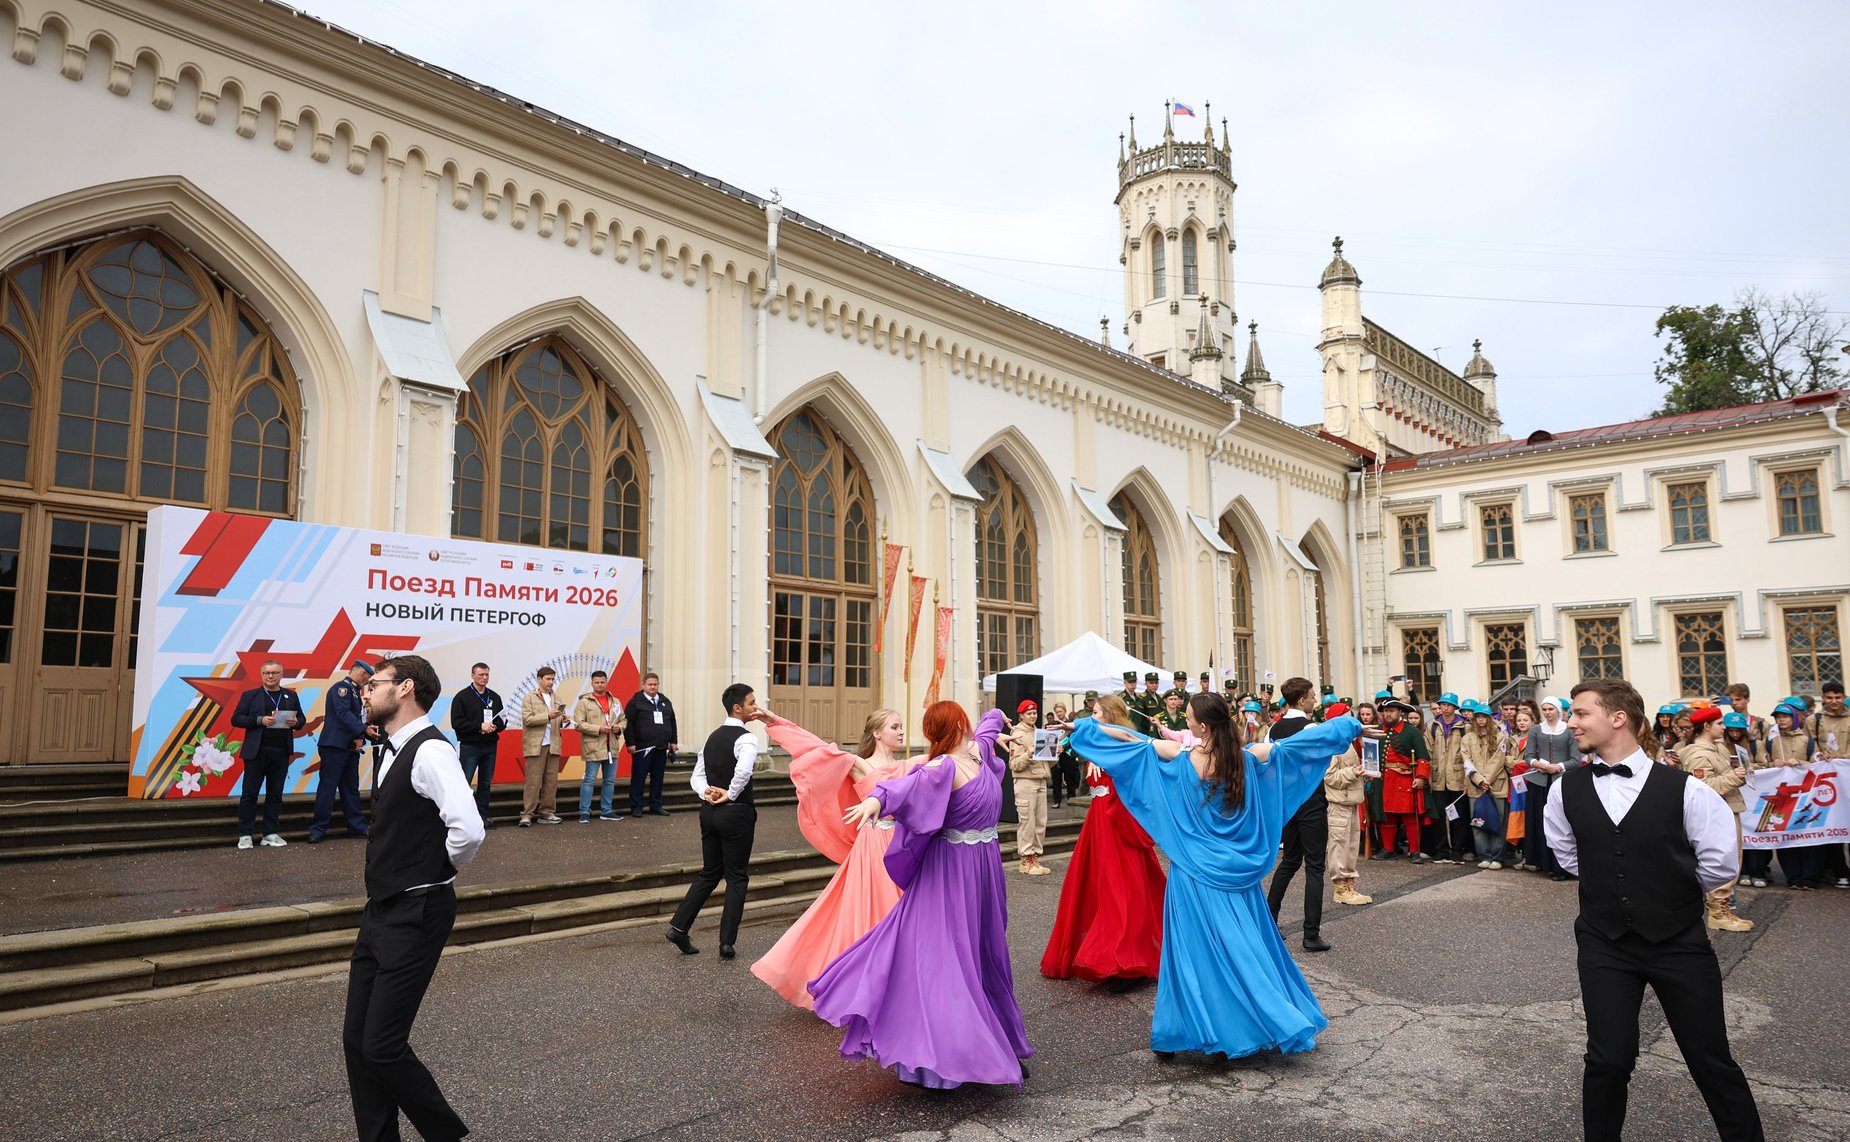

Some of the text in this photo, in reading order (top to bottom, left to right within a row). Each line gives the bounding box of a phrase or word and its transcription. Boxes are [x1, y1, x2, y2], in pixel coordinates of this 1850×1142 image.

[367, 568, 618, 607] Поезд Памяти 2026
[366, 602, 546, 627] НОВЫЙ ПЕТЕРГОФ
[1743, 835, 1780, 843] Поезд
[1782, 832, 1825, 842] Памяти
